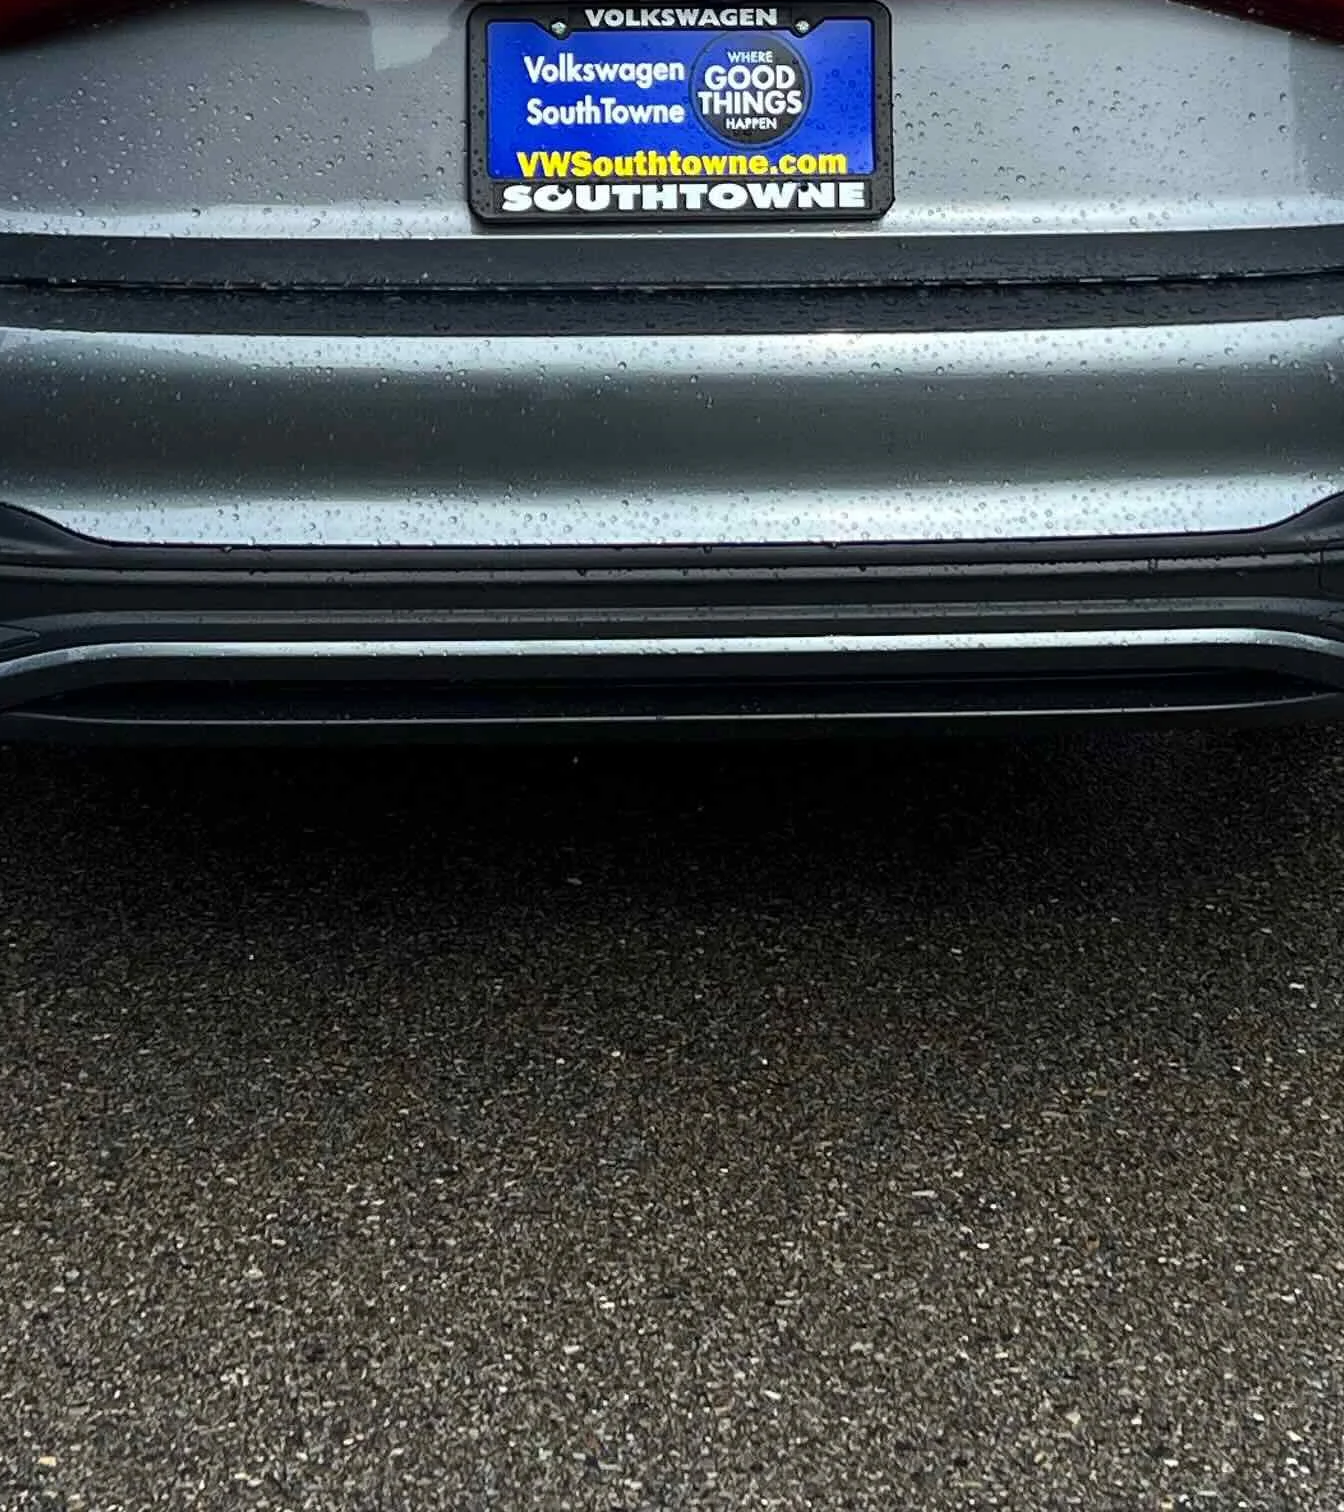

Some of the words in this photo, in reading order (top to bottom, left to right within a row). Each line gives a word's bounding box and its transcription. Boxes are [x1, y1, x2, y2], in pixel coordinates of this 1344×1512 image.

[584, 7, 778, 28] VOLKSWAGEN
[727, 50, 774, 63] WHERE
[523, 53, 685, 89] Volkswagen
[704, 65, 796, 90] GOOD
[525, 94, 686, 127] SouthTowne
[697, 90, 803, 115] THINGS
[725, 117, 777, 130] HAPPEN
[516, 151, 847, 178] VWSouthtowne.com
[501, 182, 866, 212] SOUTHTOWNE
